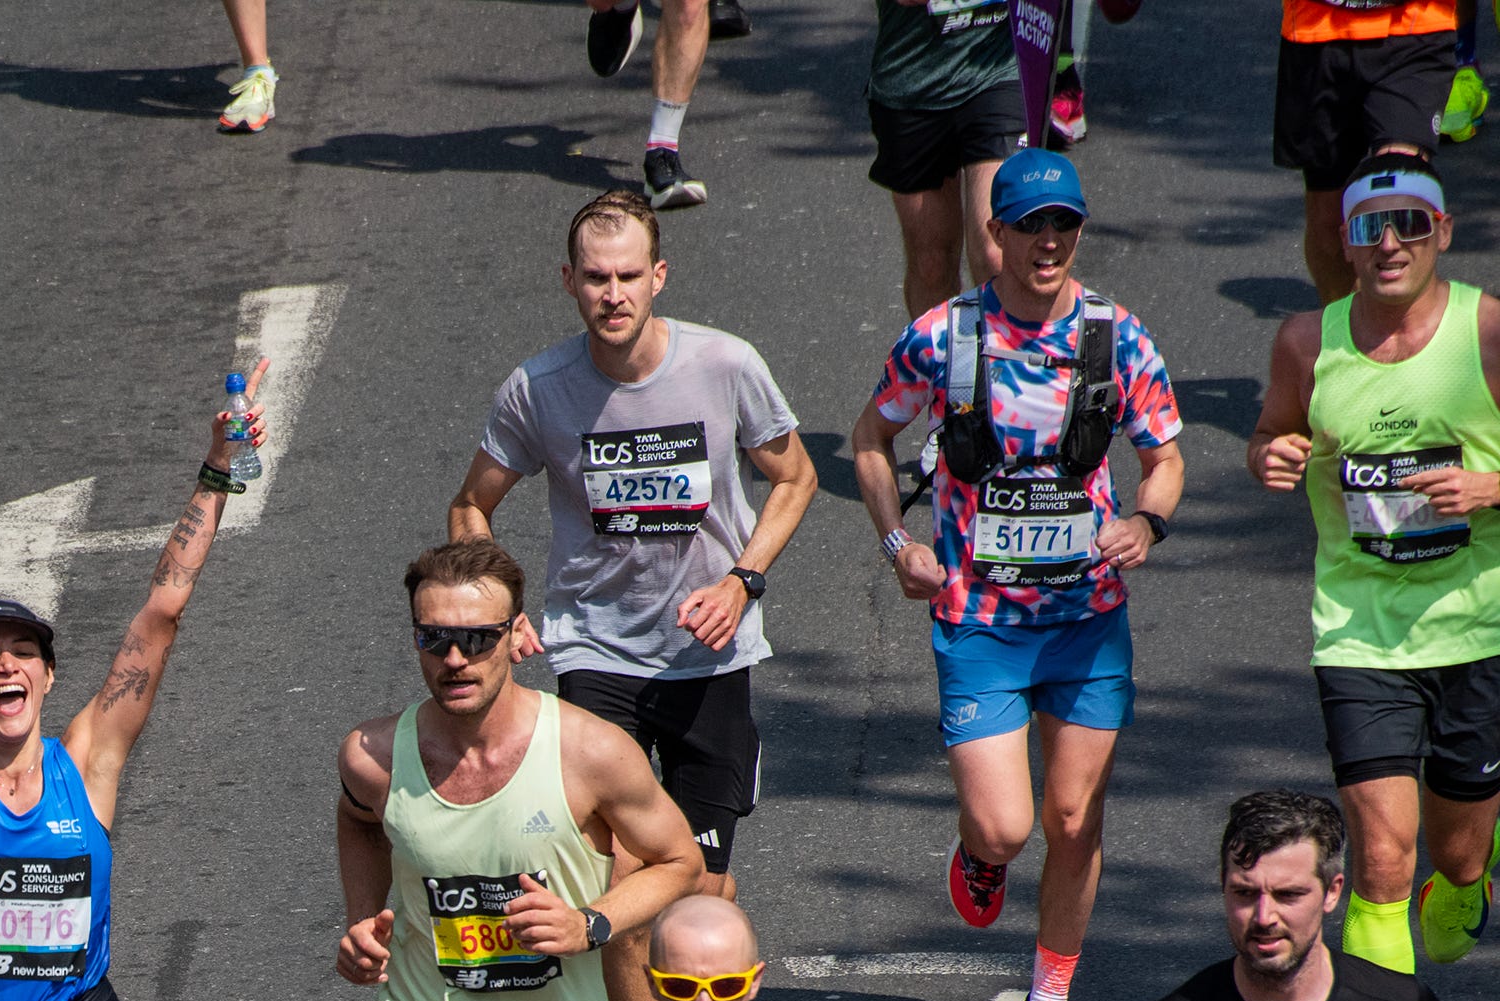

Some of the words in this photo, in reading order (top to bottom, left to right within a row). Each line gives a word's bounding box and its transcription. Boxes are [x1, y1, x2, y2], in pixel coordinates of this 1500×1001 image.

[1370, 420, 1418, 433] LONDON
[634, 434, 662, 443] TATA
[636, 438, 698, 453] CONSULTANCY
[589, 439, 633, 465] tcs
[637, 450, 677, 463] SERVICES
[1391, 456, 1418, 467] TATA
[1346, 459, 1388, 487] tcs
[606, 474, 692, 503] 42572
[1030, 483, 1058, 492] TATA
[985, 482, 1026, 511] tcs
[1030, 501, 1069, 511] SERVICES
[640, 523, 661, 532] new
[996, 524, 1072, 552] 51771
[1394, 551, 1416, 560] new
[1044, 574, 1082, 585] balance
[522, 823, 556, 834] adidas
[22, 864, 52, 873] TATA
[22, 872, 85, 884] CONSULTANCY
[22, 884, 65, 894] SERVICES
[479, 882, 505, 891] TATA
[434, 885, 478, 912] tcs
[481, 889, 525, 901] CONSULTA
[461, 924, 523, 954] 580
[13, 966, 36, 976] new
[489, 978, 512, 989] new
